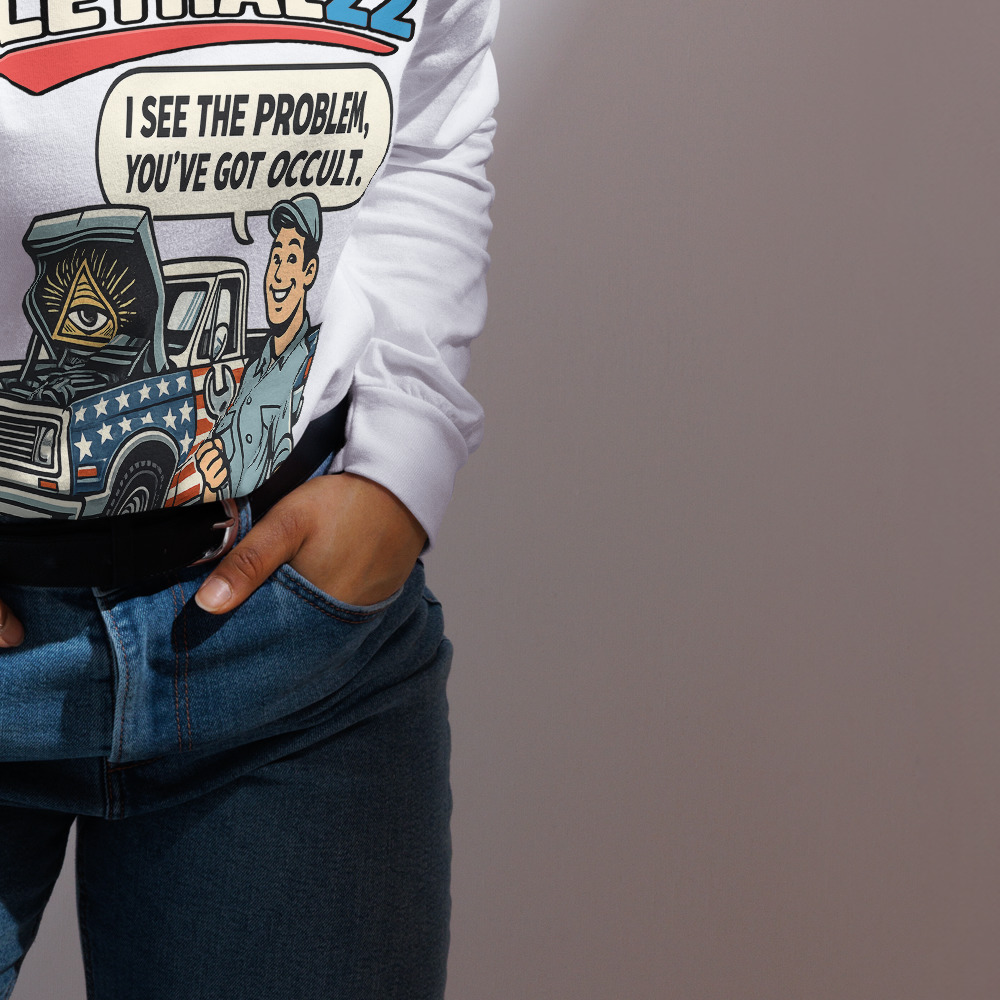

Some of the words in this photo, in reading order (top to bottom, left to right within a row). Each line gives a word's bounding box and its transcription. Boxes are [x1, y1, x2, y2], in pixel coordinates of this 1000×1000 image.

[125, 96, 133, 138] I
[140, 95, 191, 138] SEE
[197, 94, 249, 137] THE
[253, 90, 370, 138] PROBLEM,
[125, 150, 211, 193] YOU'VE
[214, 150, 266, 191] GOT
[267, 149, 363, 187] OCCULT.
